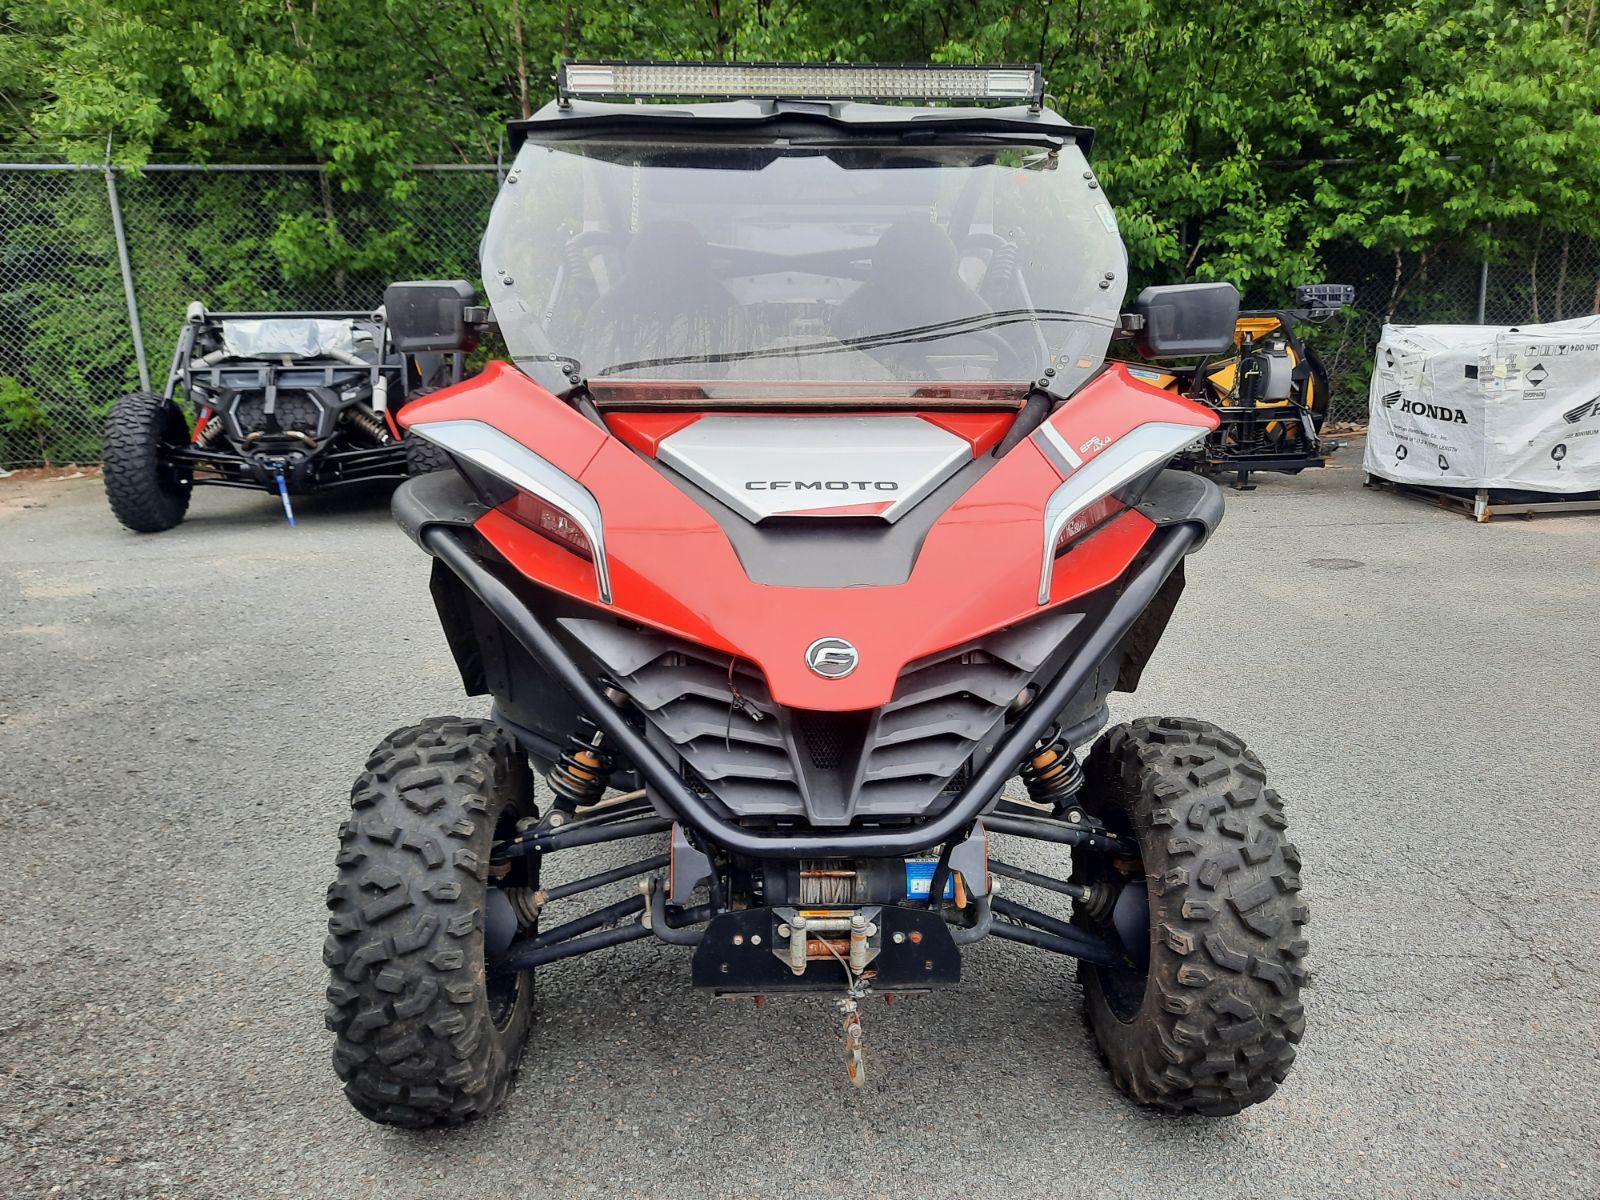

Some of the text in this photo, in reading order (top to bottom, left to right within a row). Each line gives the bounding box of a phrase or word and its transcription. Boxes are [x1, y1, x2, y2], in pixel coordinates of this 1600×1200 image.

[1574, 343, 1600, 352] DO NOT
[1401, 398, 1468, 424] HONDA
[1079, 435, 1100, 453] EPS
[745, 481, 898, 491] CFMOTO
